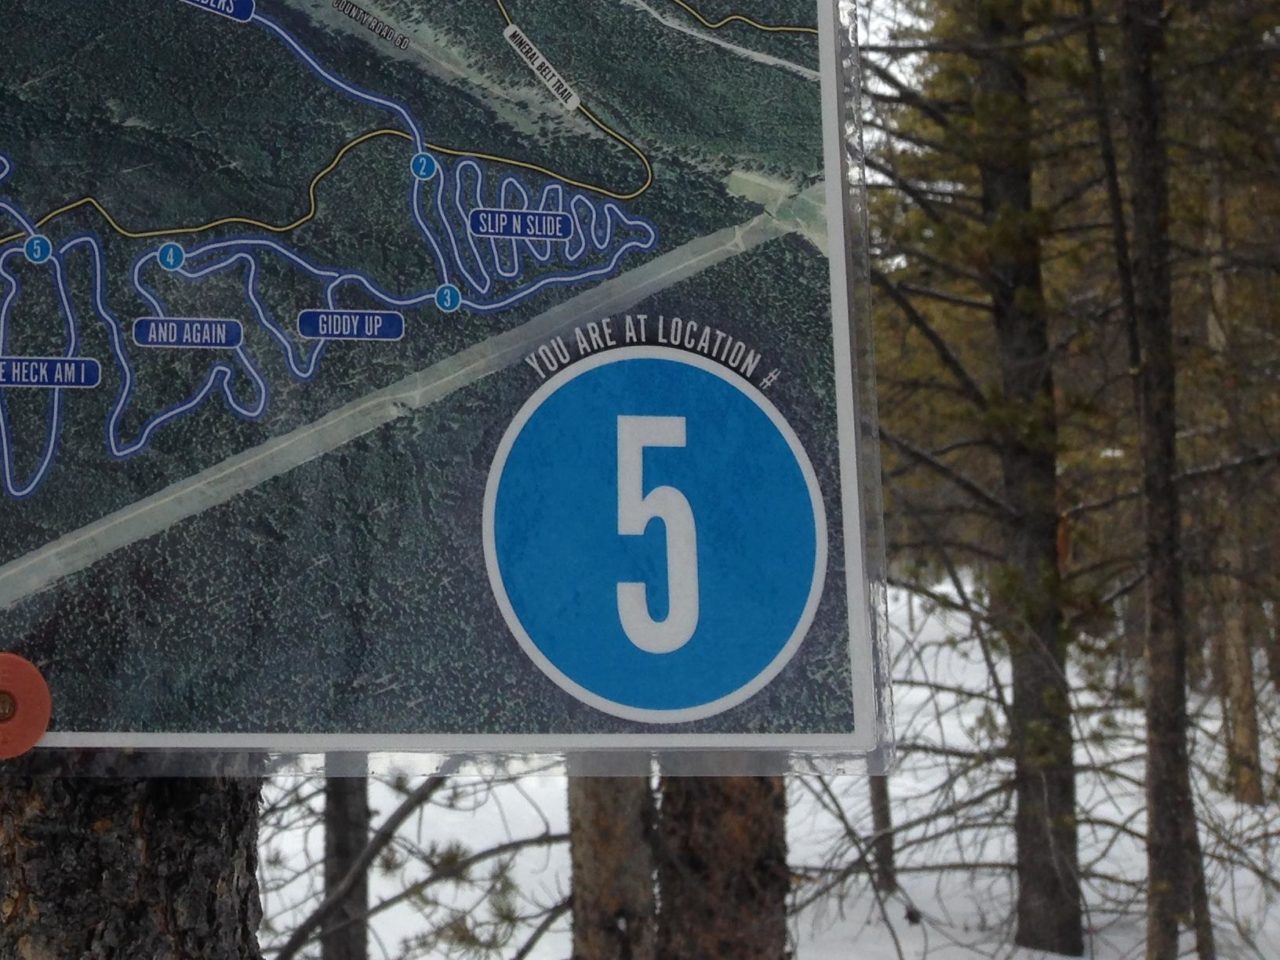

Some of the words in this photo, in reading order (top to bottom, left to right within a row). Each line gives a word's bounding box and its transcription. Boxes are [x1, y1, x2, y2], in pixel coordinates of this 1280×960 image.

[369, 18, 395, 41] ROAD
[508, 29, 540, 66] MINERAL
[536, 61, 556, 83] BELT
[551, 78, 573, 104] TRAIL
[479, 212, 507, 234] SLIP
[511, 215, 521, 235] N
[526, 215, 563, 237] SLIDE
[147, 322, 177, 344] AND
[182, 323, 227, 345] AGAIN
[318, 314, 359, 337] GIDDY
[364, 315, 383, 338] UP
[524, 335, 571, 379] YOU
[574, 318, 617, 355] ARE
[625, 314, 648, 343] AT
[658, 315, 762, 378] LOCATION
[11, 362, 48, 384] HECK
[54, 363, 76, 384] AM
[616, 415, 700, 655] 5
